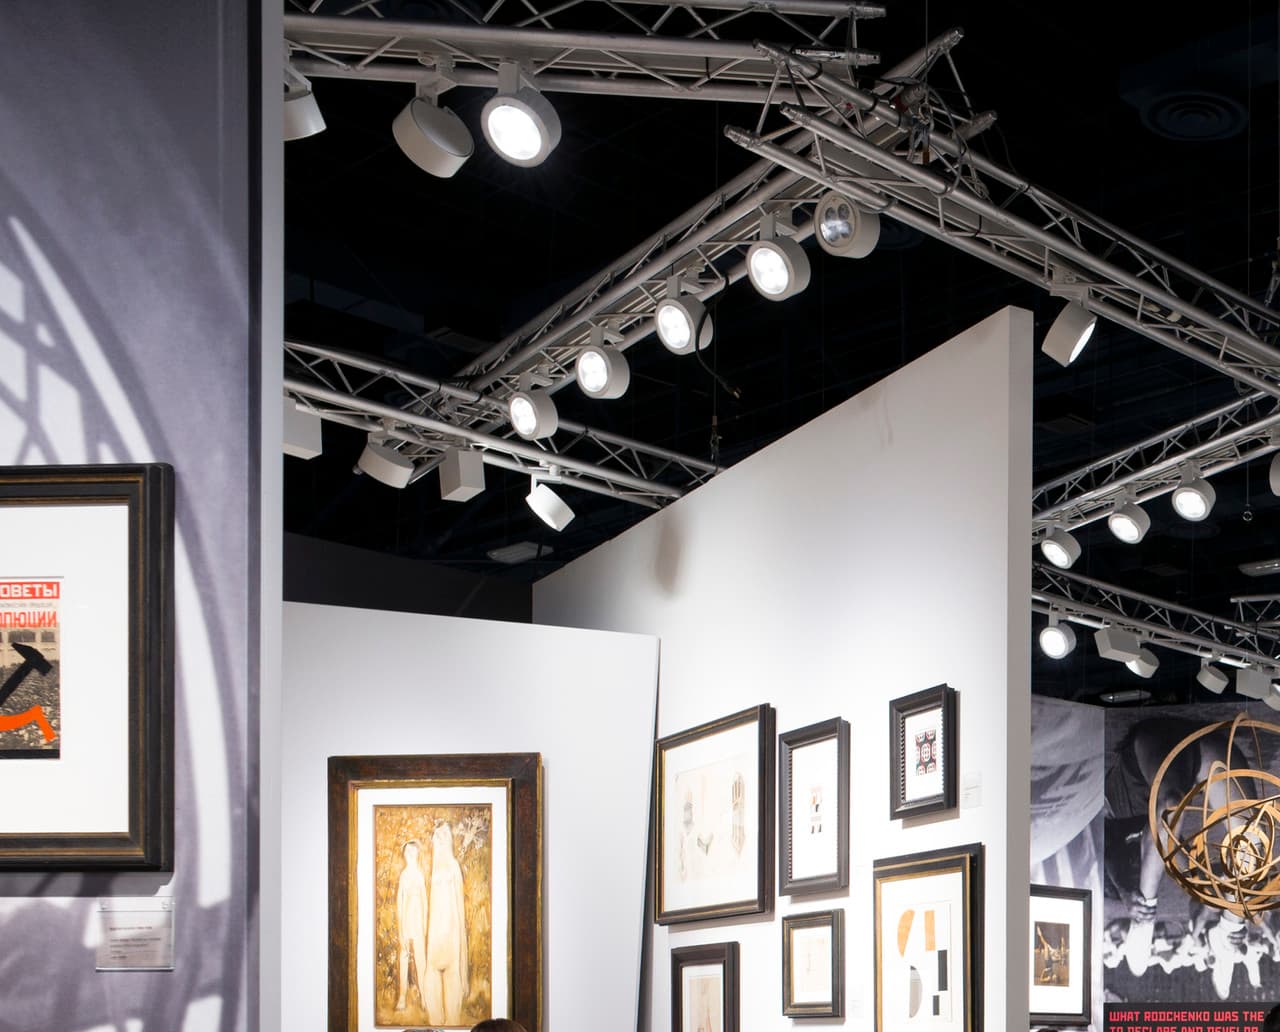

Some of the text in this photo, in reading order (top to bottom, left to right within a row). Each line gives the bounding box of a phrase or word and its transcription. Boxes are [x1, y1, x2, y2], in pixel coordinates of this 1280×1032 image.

[0, 611, 57, 628] ЛЮЦИИ
[1109, 1011, 1265, 1022] WHAT RODCHENKO WAS THE
